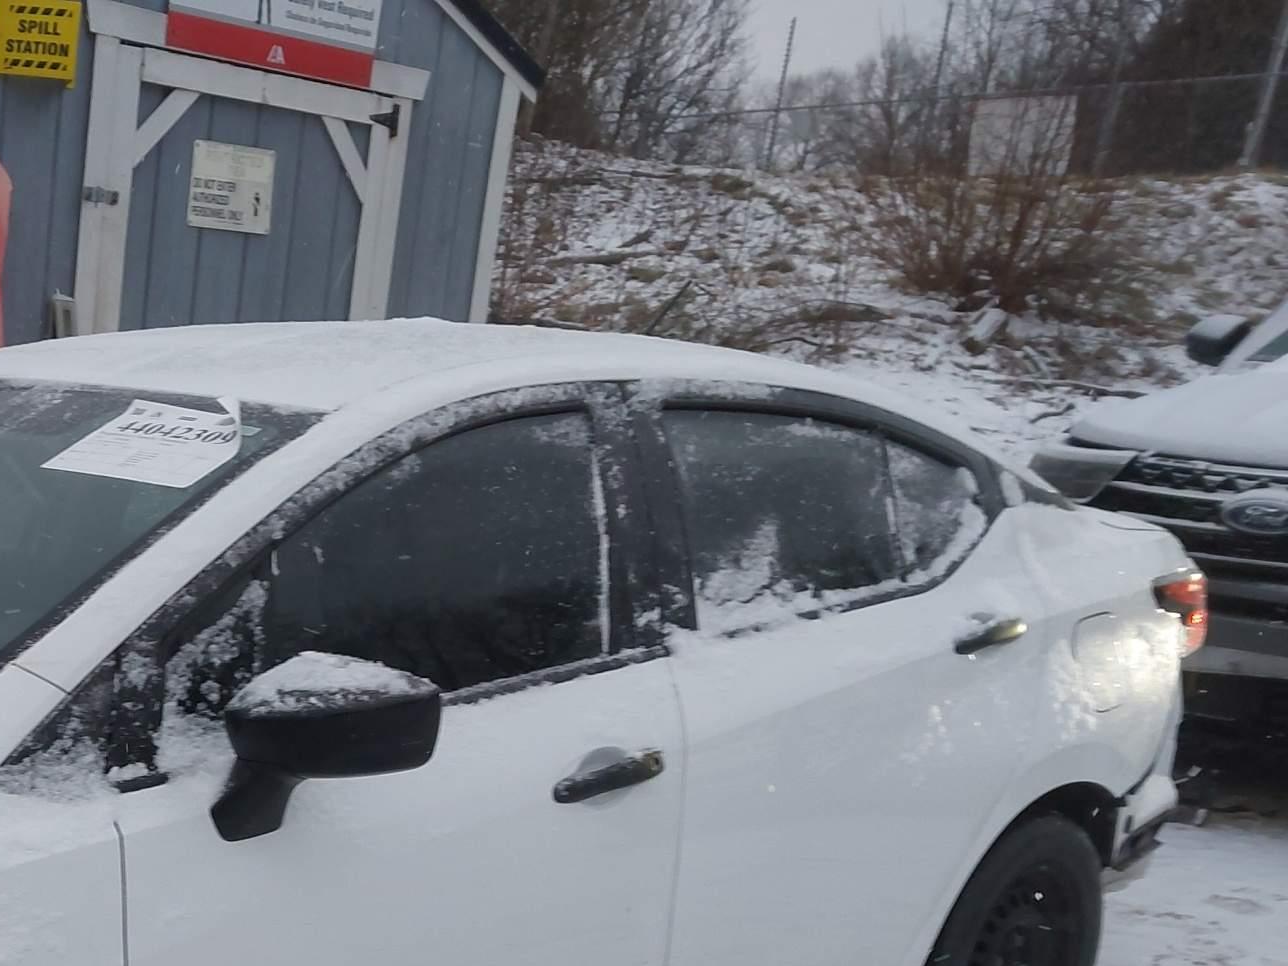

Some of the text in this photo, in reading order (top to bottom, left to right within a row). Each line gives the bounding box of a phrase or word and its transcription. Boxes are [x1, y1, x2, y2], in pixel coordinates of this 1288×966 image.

[17, 20, 61, 36] SPILL
[6, 39, 69, 57] STATION
[117, 420, 238, 445] 44042309
